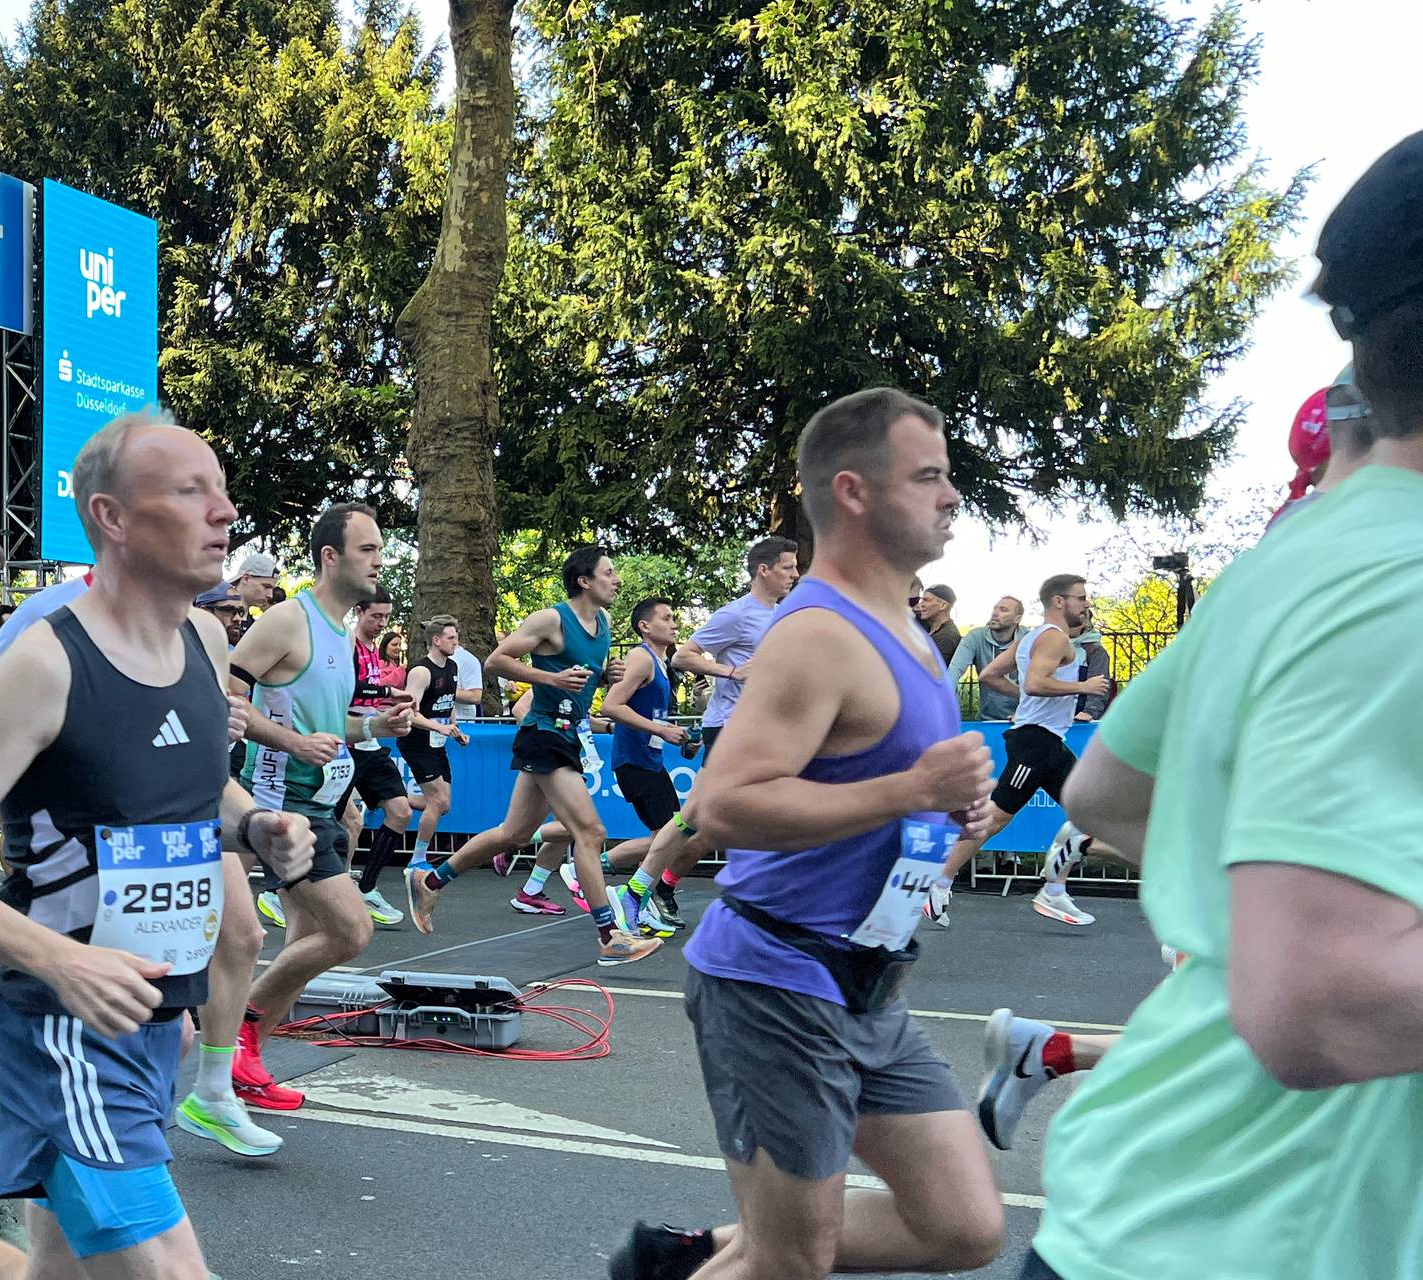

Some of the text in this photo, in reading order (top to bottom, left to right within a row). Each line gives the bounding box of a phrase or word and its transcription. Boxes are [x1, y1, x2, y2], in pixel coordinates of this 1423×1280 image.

[80, 247, 114, 287] uni
[87, 279, 126, 319] per
[76, 368, 145, 400] Stadtsparkasse
[76, 392, 127, 417] Düsseldorf
[161, 826, 187, 845] uni
[112, 845, 145, 865] per
[166, 842, 193, 863] per
[122, 877, 211, 914] 2938
[135, 916, 202, 934] ALEXANDER
